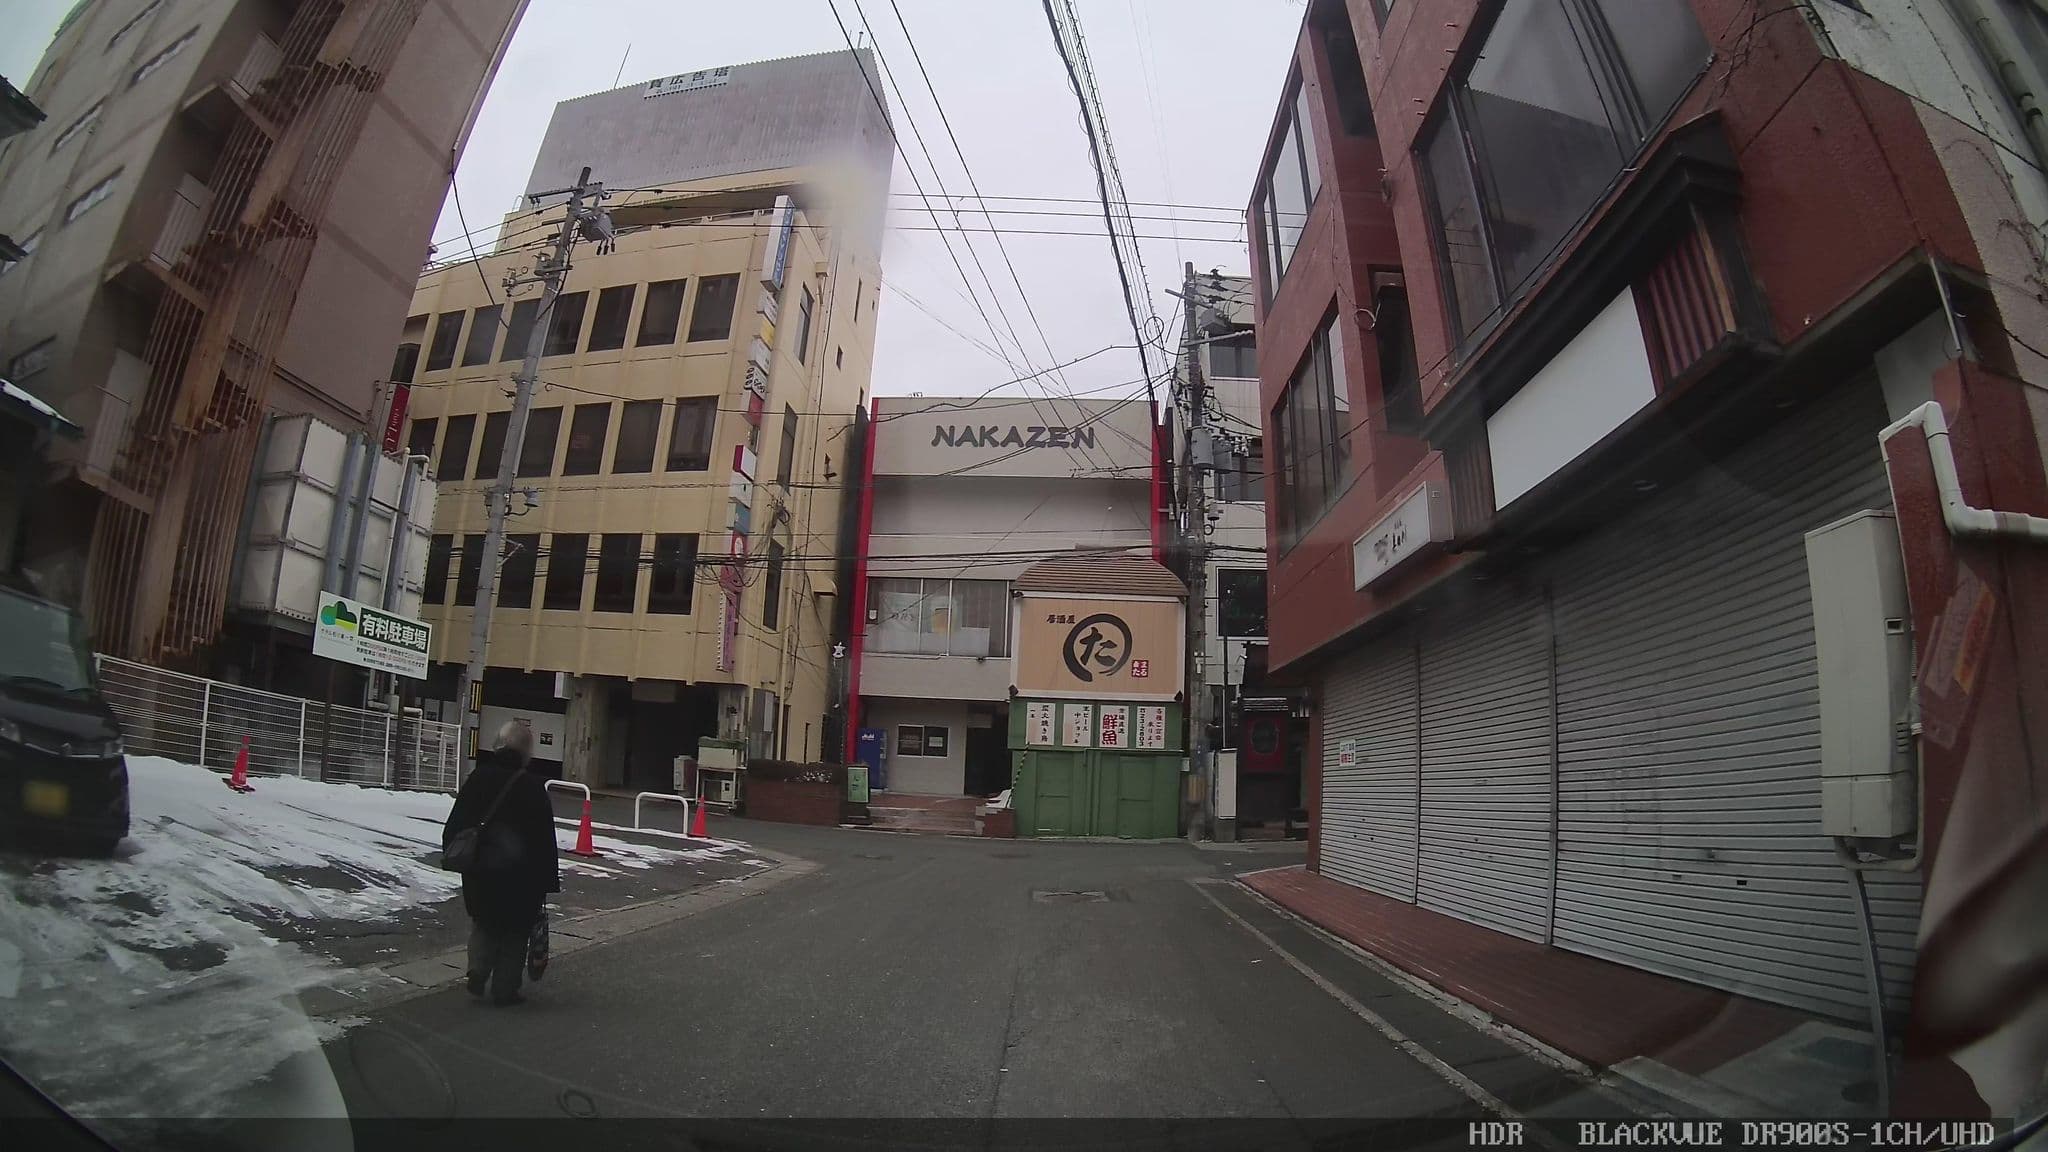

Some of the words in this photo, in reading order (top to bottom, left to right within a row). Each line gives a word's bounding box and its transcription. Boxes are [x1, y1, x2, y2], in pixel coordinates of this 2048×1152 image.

[931, 425, 1095, 449] NAKAZEN
[362, 613, 426, 650] 有料駐車場
[1046, 614, 1077, 625] 居酒屋
[1102, 713, 1118, 745] 鮮魚
